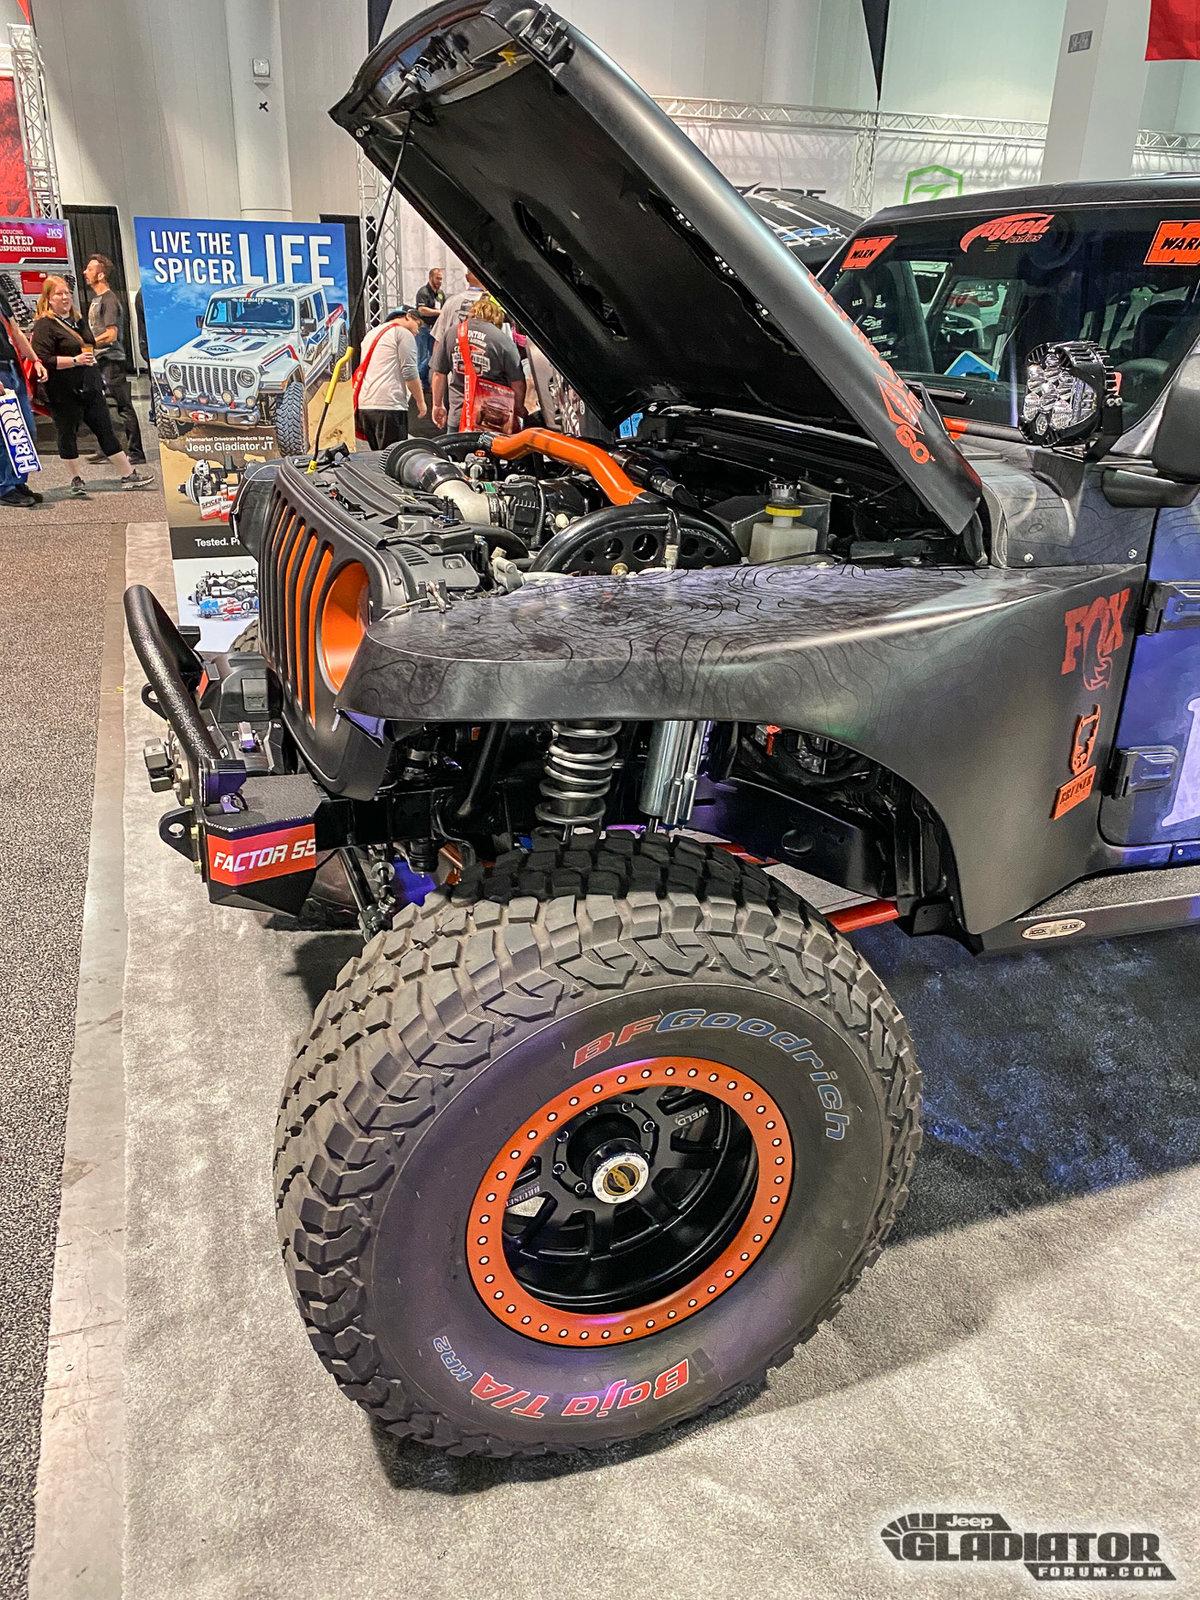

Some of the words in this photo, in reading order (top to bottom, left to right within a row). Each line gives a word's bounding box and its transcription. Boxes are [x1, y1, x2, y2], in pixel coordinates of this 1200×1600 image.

[46, 228, 63, 239] JKS
[151, 231, 192, 254] LIVE
[197, 232, 233, 255] THE
[154, 257, 237, 285] SPICER
[238, 233, 335, 286] LIFE
[214, 442, 260, 452] Gladiator
[261, 441, 274, 450] JT
[195, 538, 229, 547] Tested.
[1061, 588, 1131, 684] FOX
[213, 844, 288, 873] FACTOR
[291, 838, 317, 860] 55
[573, 1008, 850, 1141] BFGoodrich
[677, 1106, 709, 1126] WELD
[433, 1335, 472, 1382] KR2
[470, 1372, 550, 1419] T/A
[561, 1358, 689, 1418] Baja
